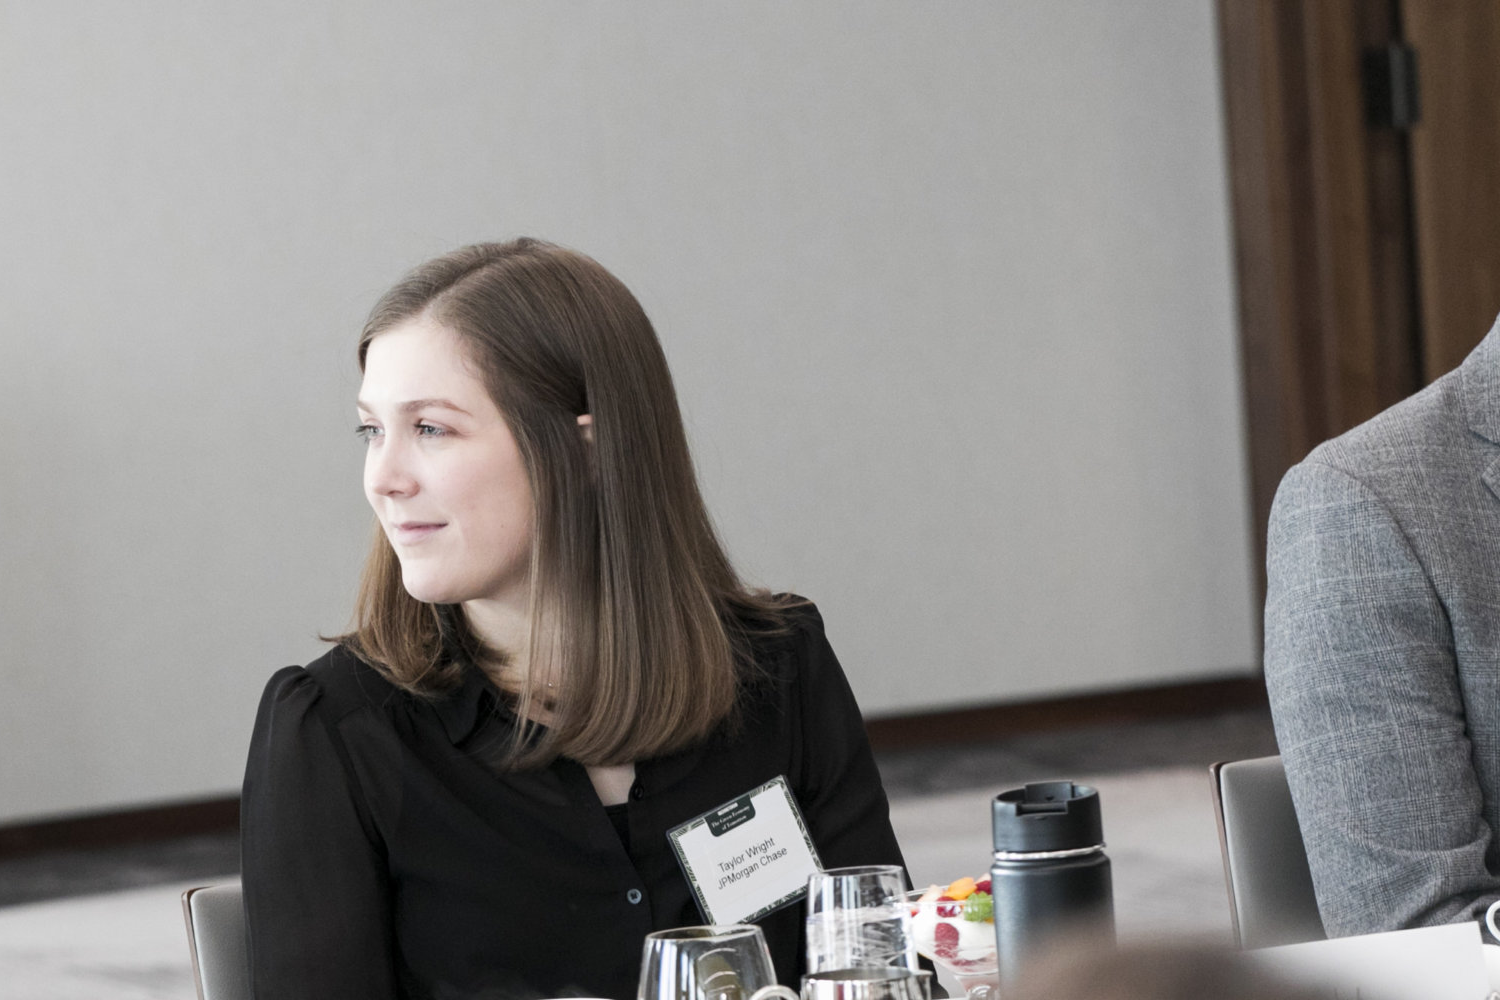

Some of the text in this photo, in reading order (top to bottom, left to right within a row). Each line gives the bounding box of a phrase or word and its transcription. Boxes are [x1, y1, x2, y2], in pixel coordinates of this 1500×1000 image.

[718, 837, 775, 873] Taylor Wright
[718, 847, 787, 890] JPMorgan Chase
